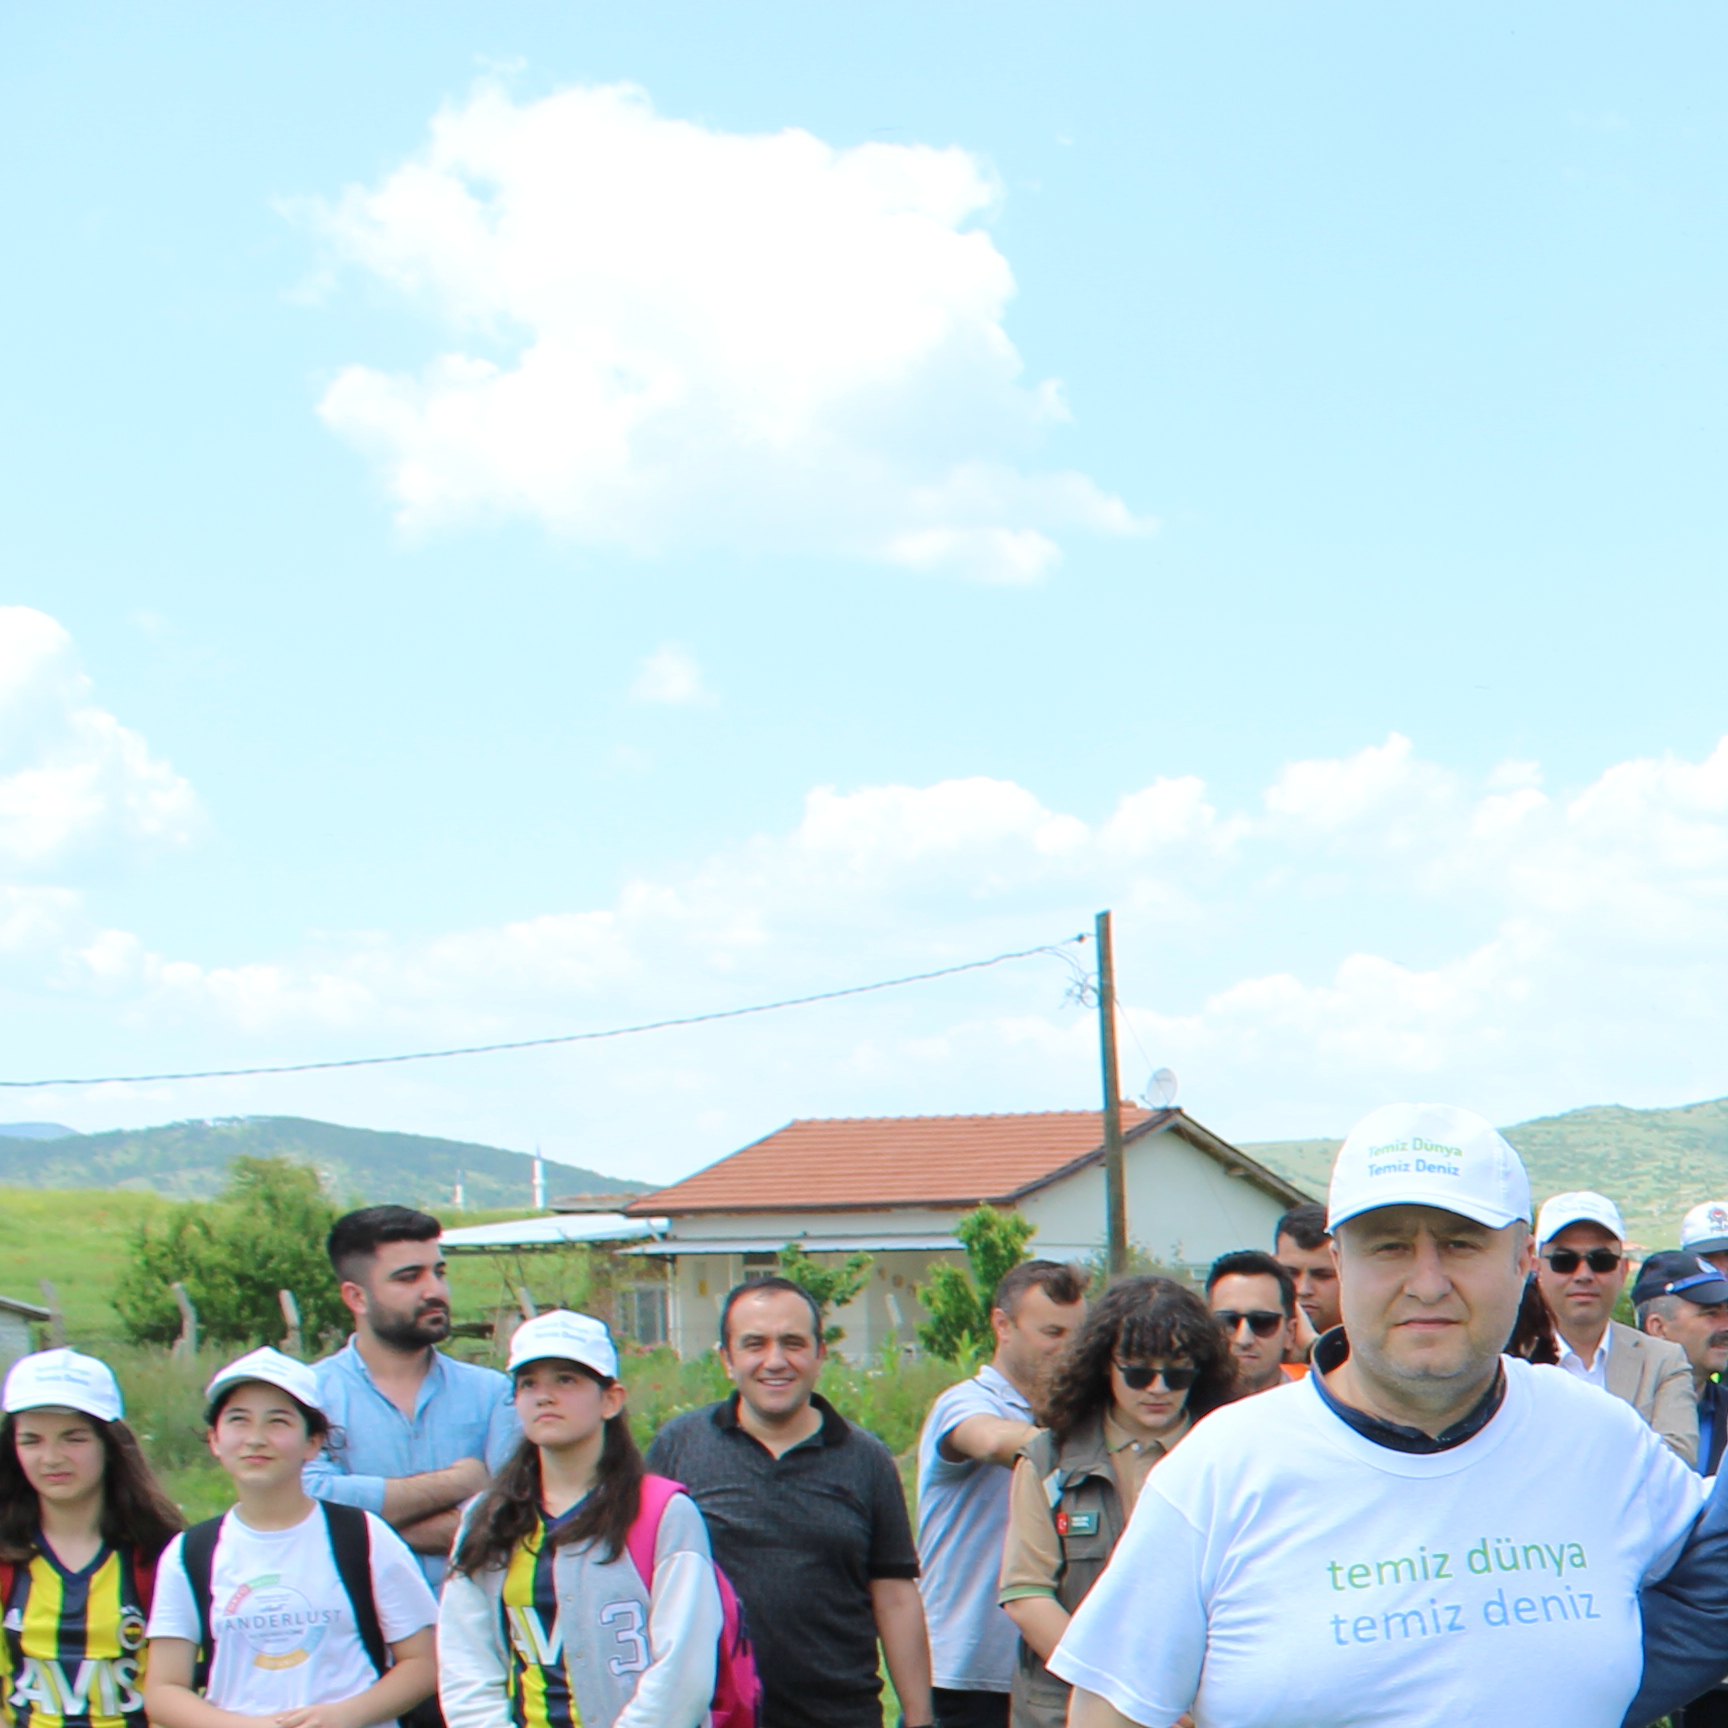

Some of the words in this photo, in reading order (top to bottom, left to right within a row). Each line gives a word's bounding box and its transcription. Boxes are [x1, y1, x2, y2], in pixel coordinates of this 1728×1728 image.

[1368, 1138, 1409, 1158] Temiz
[1412, 1136, 1463, 1158] Dünya
[1368, 1159, 1411, 1178] Temiz
[1415, 1158, 1461, 1177] Deniz
[1326, 1545, 1453, 1592] temiz
[1467, 1537, 1588, 1578] dünya
[600, 1599, 650, 1677] 3
[1329, 1597, 1466, 1647] temiz
[1482, 1584, 1602, 1628] deniz
[8, 1656, 145, 1717] AVIS
